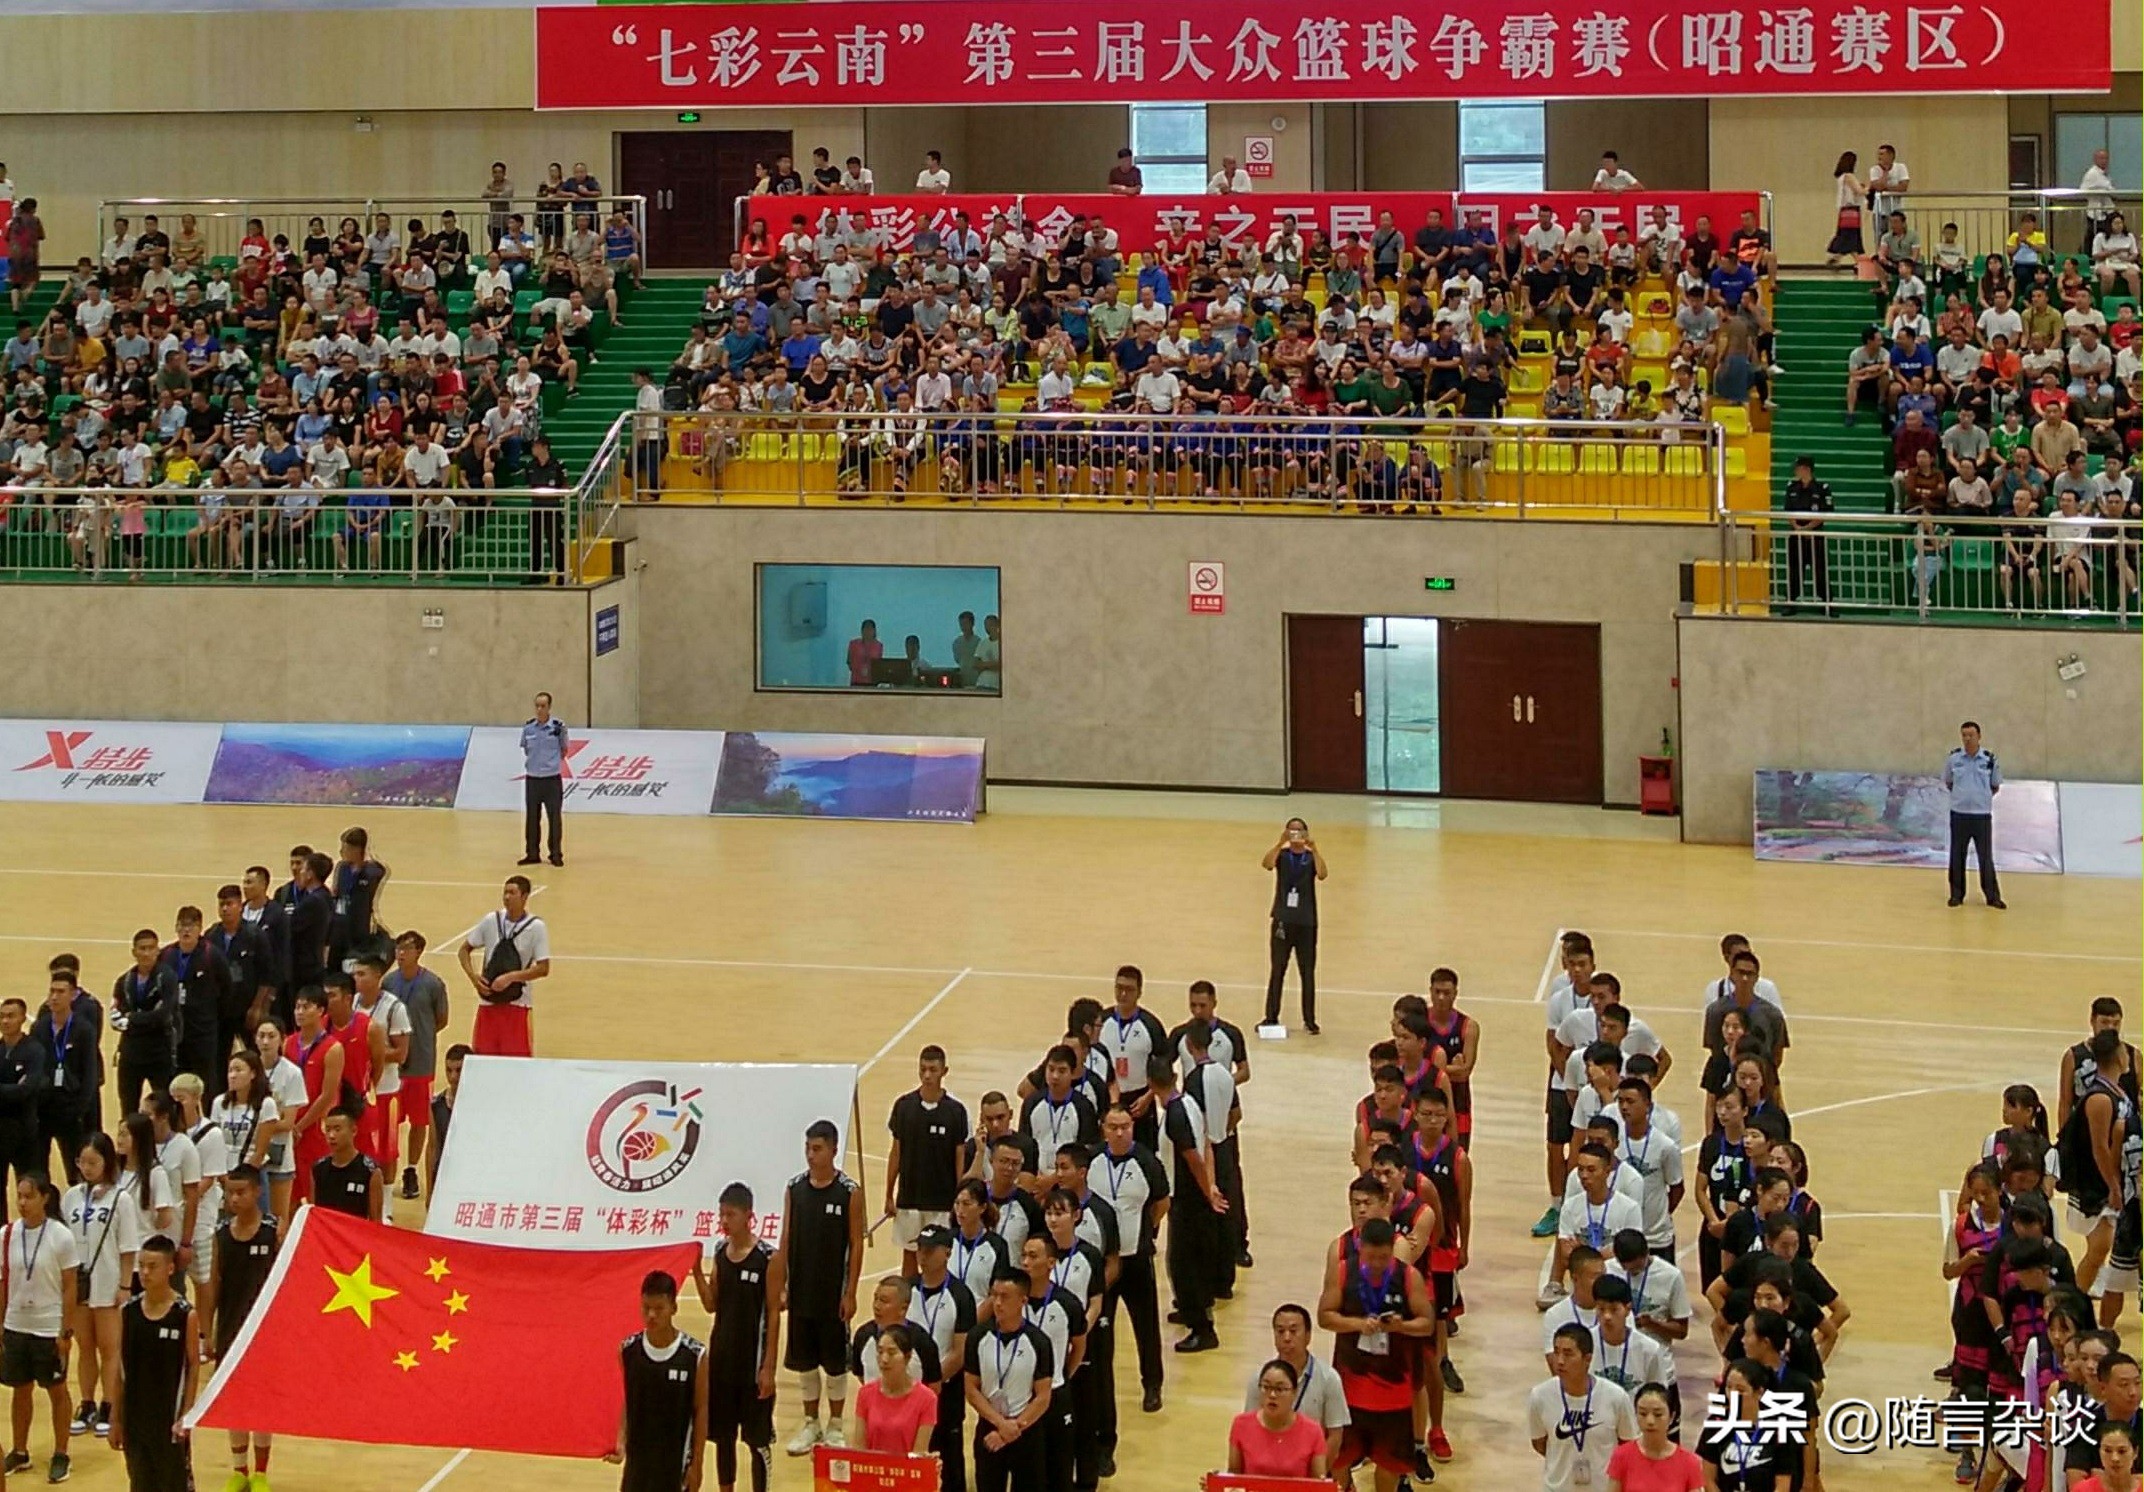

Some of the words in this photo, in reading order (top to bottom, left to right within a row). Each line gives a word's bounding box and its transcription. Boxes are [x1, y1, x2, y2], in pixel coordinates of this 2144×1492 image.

[611, 4, 2006, 89] “七彩云南”第三届大众篮球争霸赛（昭通赛区）
[77, 747, 153, 771] 特步
[576, 755, 655, 780] 特步
[454, 1202, 780, 1239] 昭通市第三届“体彩杯”篮庄
